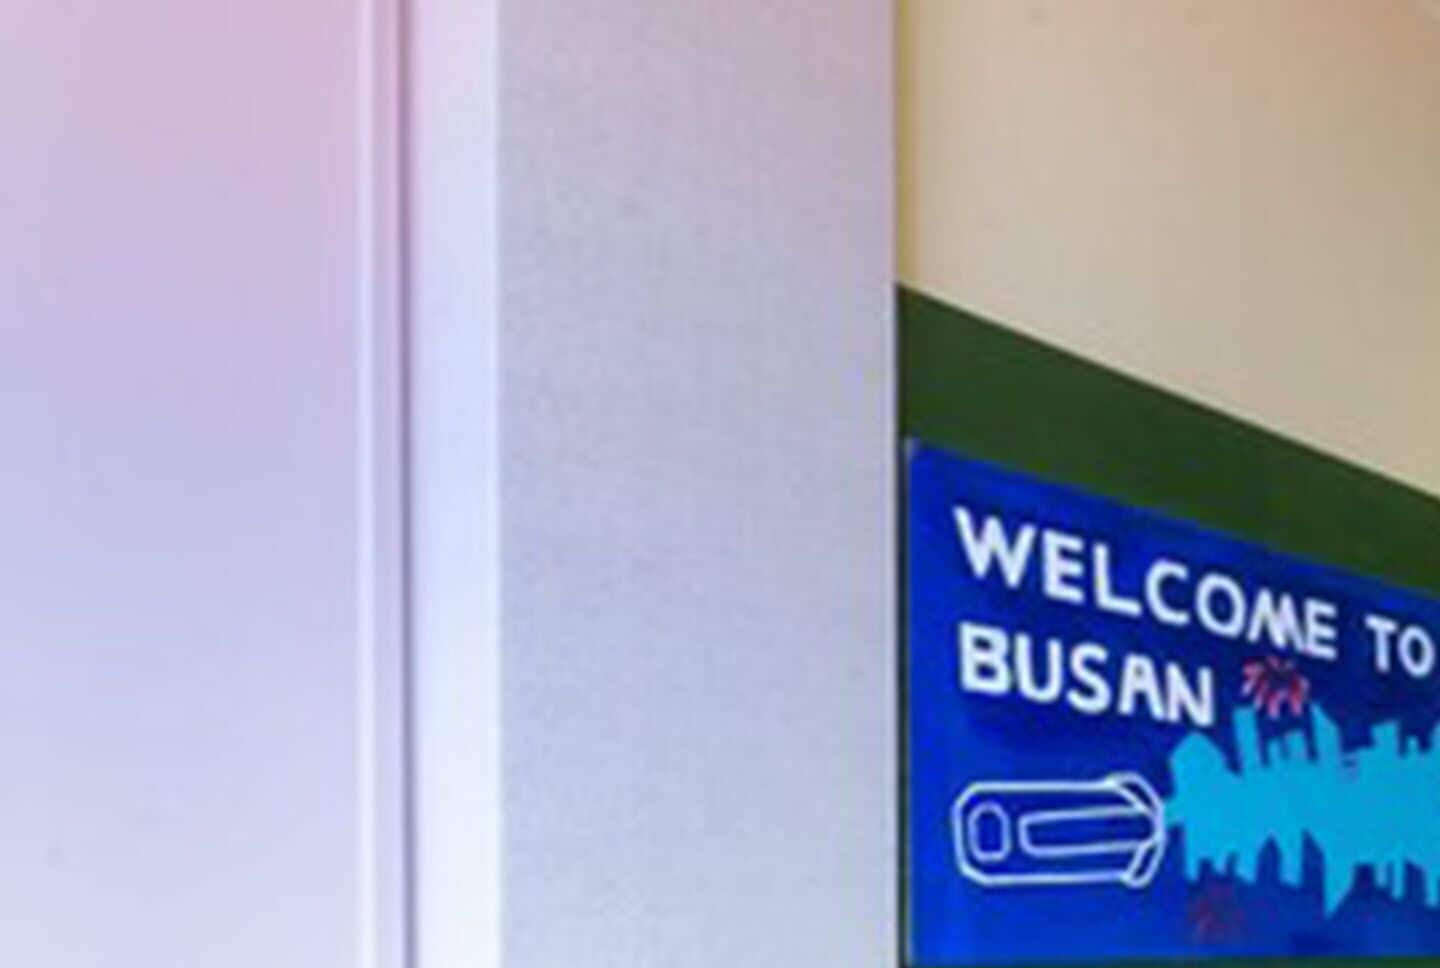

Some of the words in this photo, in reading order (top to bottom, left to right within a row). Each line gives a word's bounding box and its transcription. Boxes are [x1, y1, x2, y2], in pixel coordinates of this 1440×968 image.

[953, 506, 1338, 659] WELCOME
[1364, 612, 1435, 677] TO
[957, 621, 1214, 726] BUSAN
